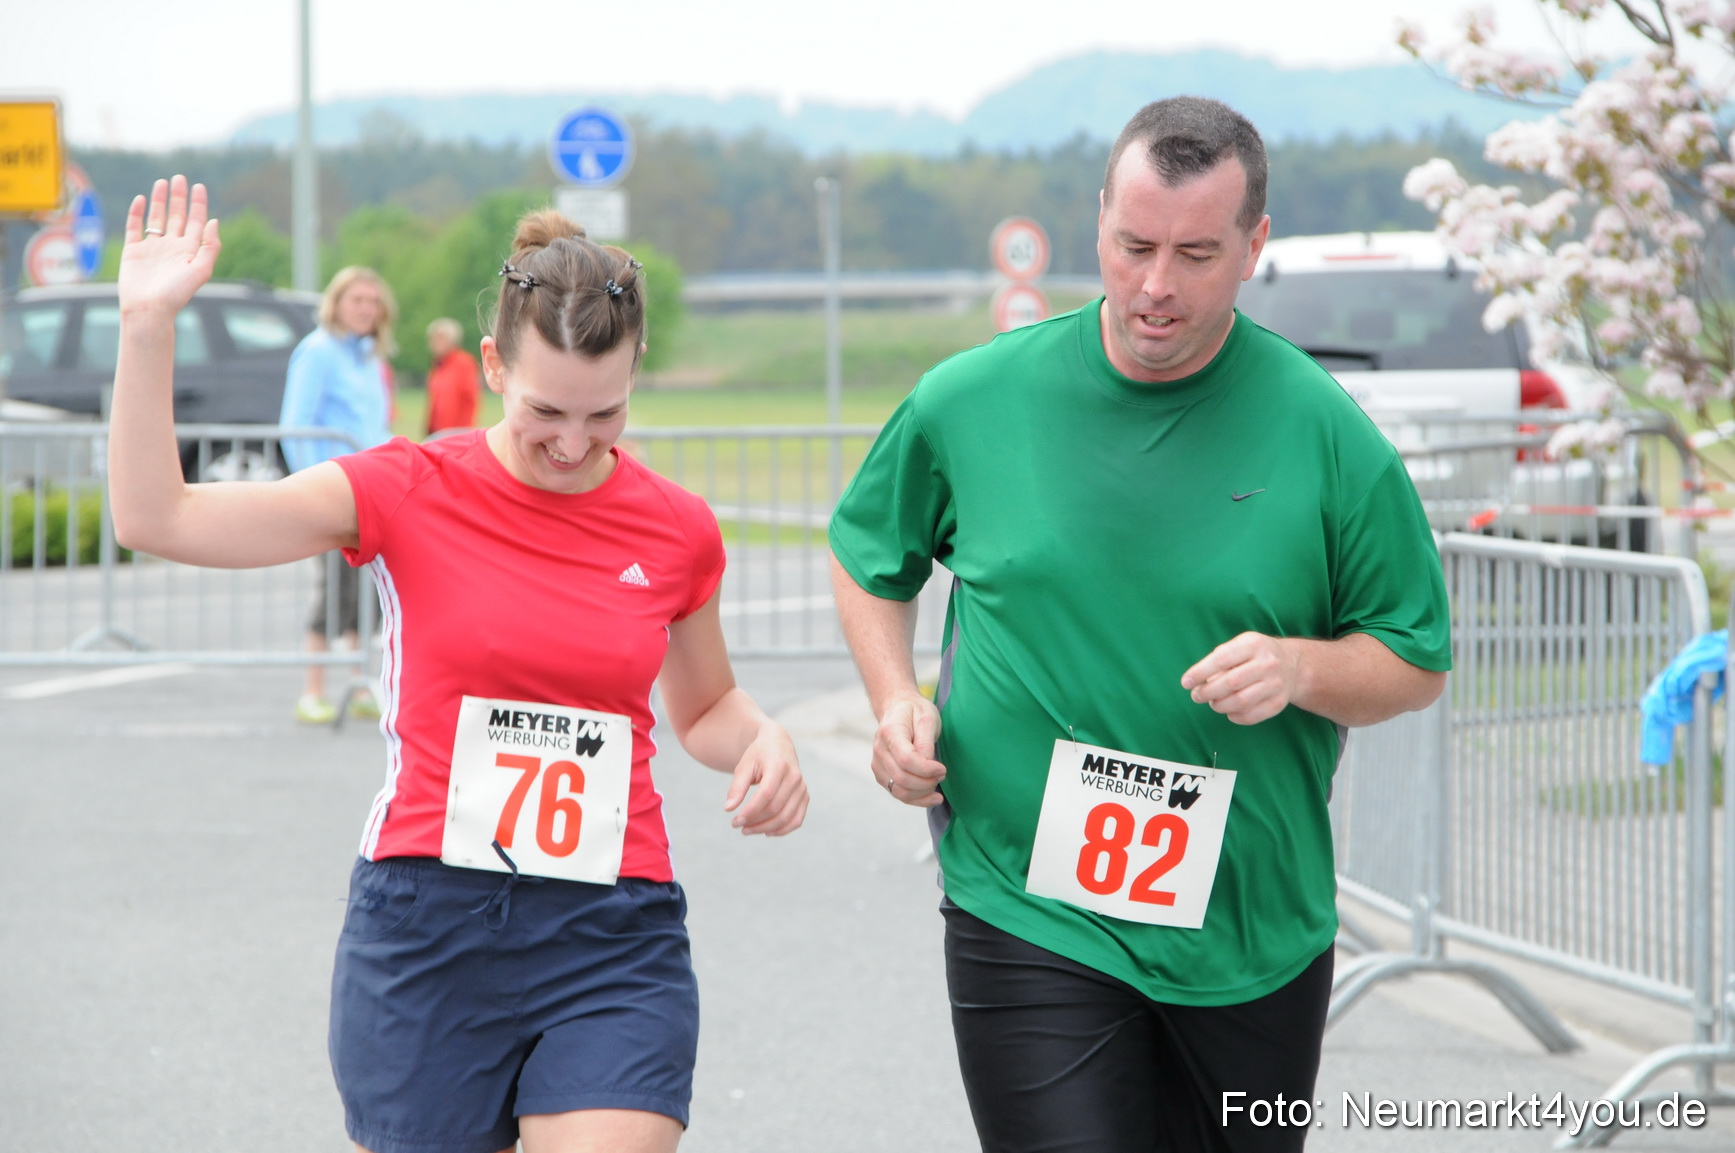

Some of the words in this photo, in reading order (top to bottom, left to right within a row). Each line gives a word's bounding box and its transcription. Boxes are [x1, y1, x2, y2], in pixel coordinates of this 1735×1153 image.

[619, 574, 650, 587] adidas
[489, 708, 571, 735] MEYER
[487, 728, 571, 751] WERBUNG
[1082, 753, 1167, 788] MEYER
[1080, 772, 1164, 802] WERBUNG
[494, 752, 586, 858] 76
[1075, 802, 1190, 907] 82
